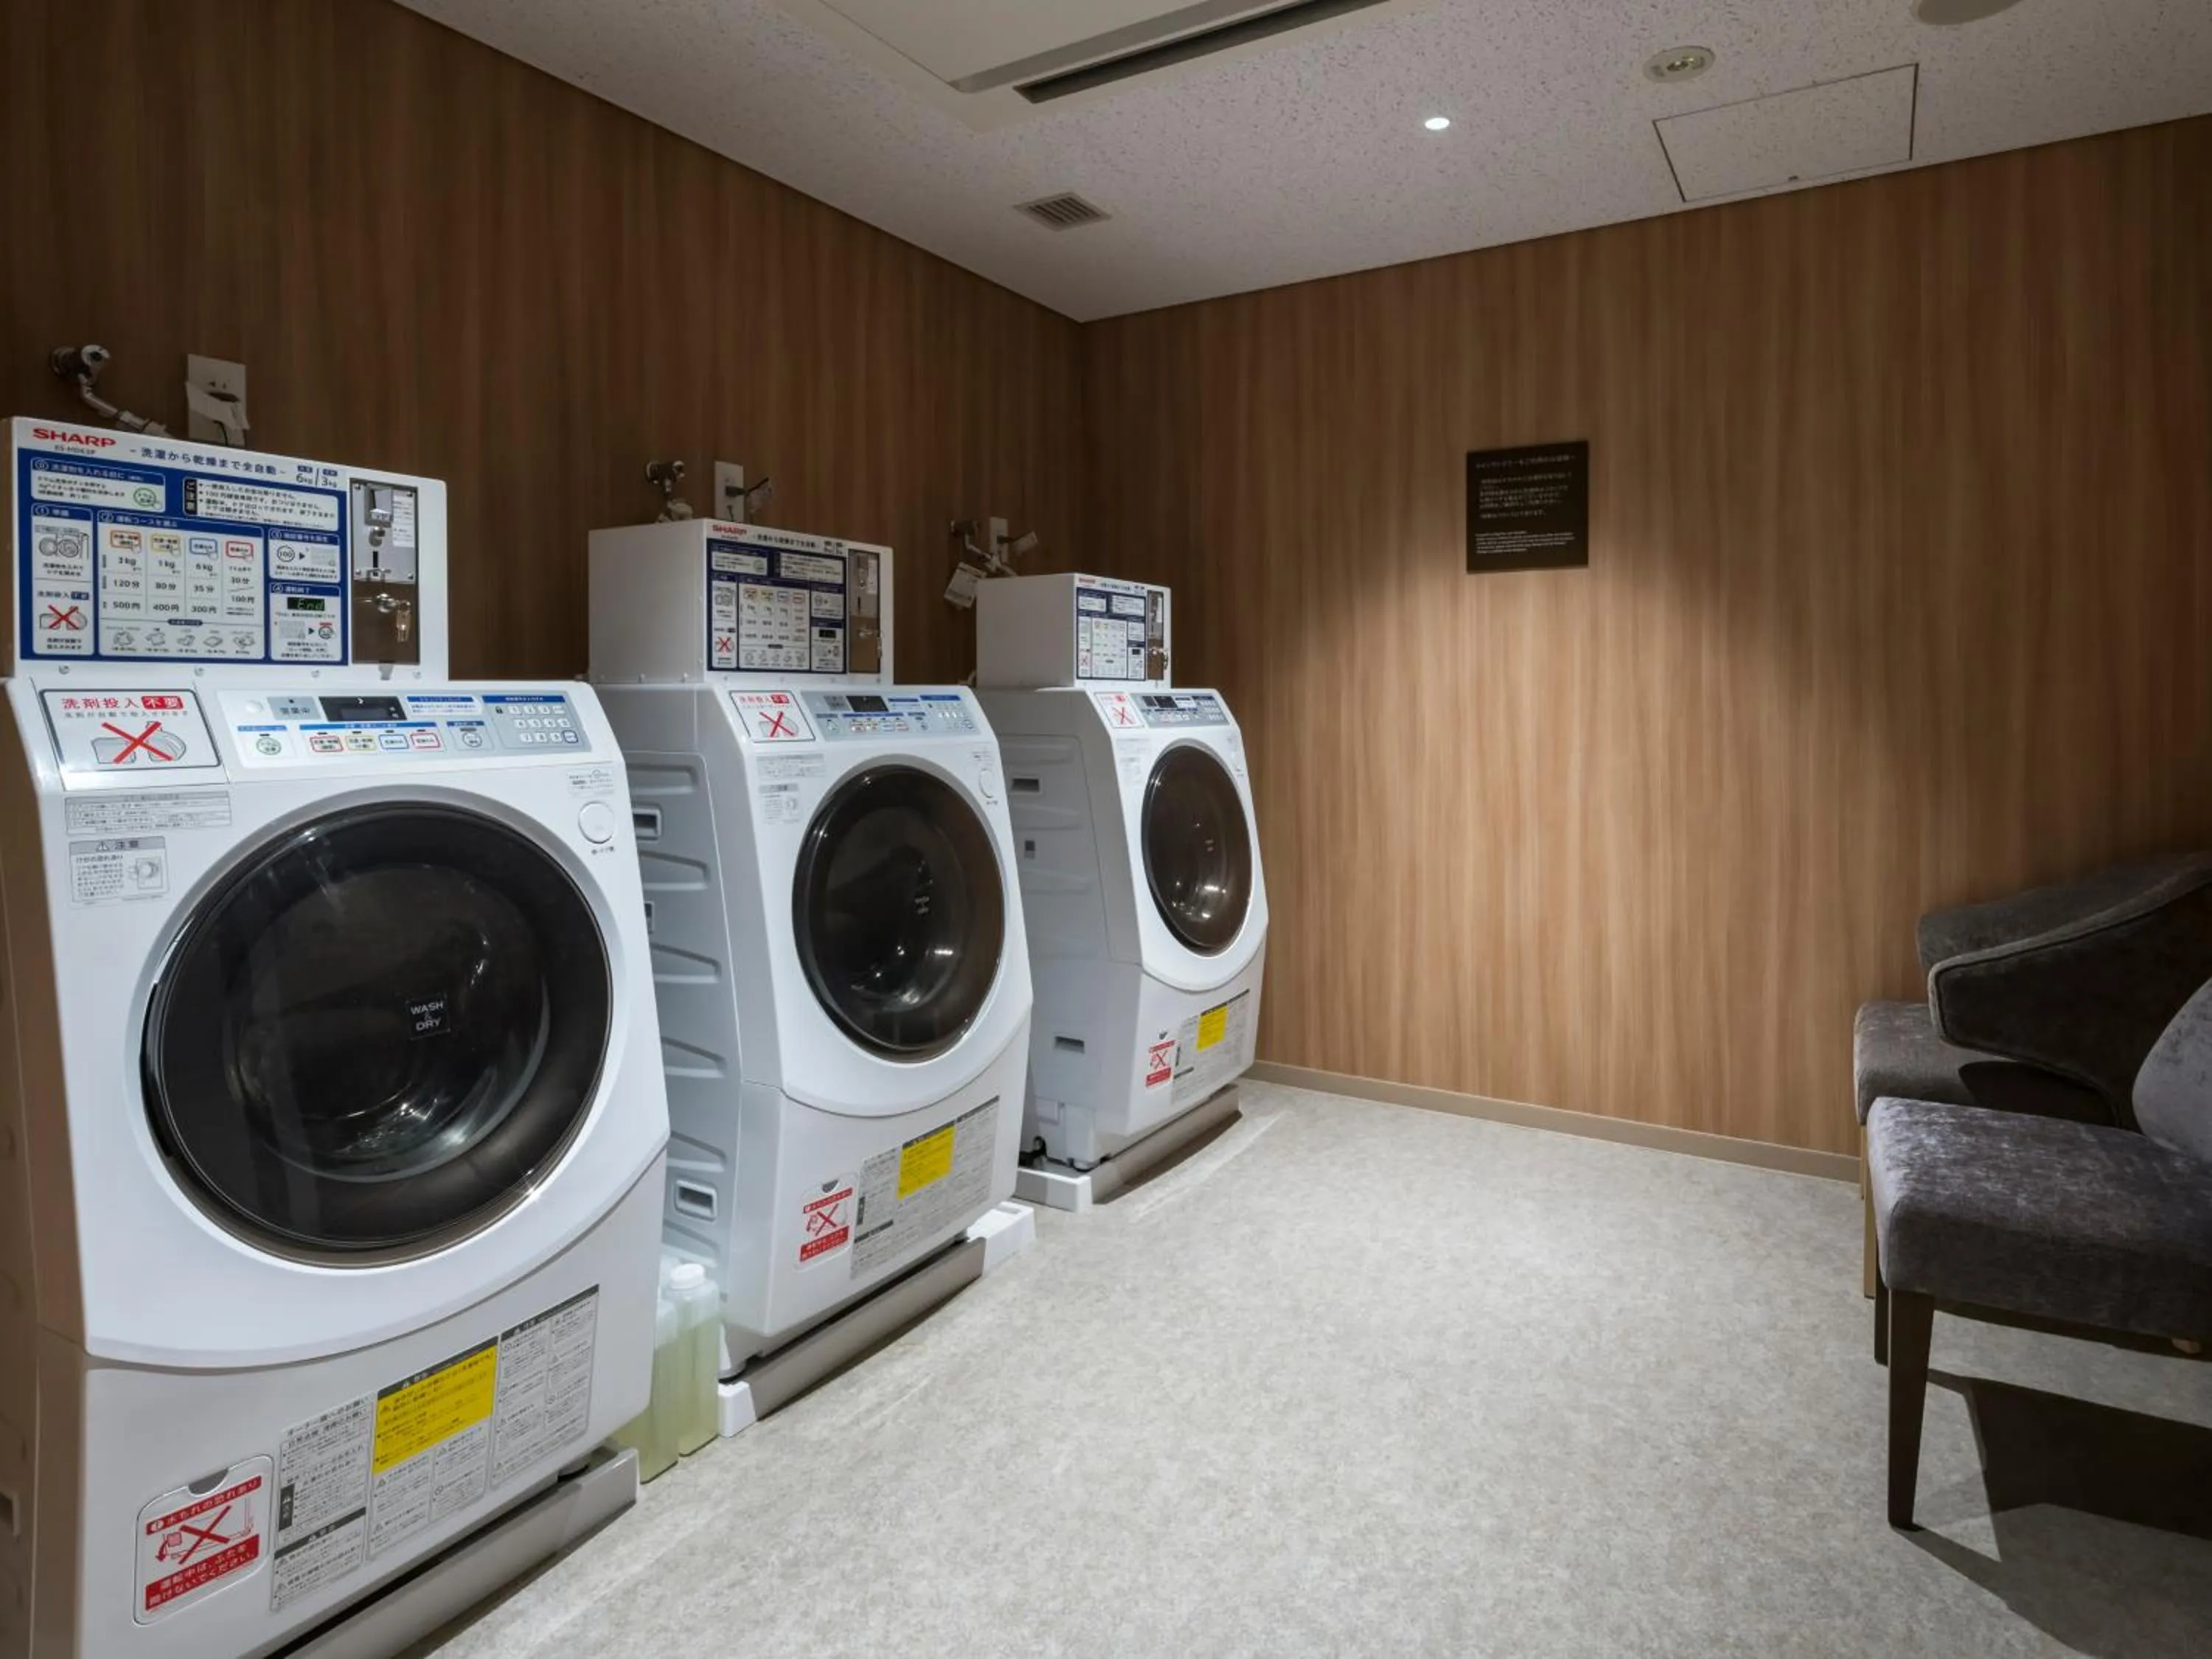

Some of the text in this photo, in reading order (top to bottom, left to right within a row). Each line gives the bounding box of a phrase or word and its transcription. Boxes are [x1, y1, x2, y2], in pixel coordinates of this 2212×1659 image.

[32, 428, 116, 448] SHARP
[141, 447, 277, 475] 洗濯から乾燥まで全自動
[712, 524, 747, 536] SHARP
[114, 579, 140, 589] 120分
[112, 601, 141, 611] 500円
[153, 604, 180, 613] 400円
[231, 594, 255, 605] 100円
[297, 598, 324, 611] End
[62, 697, 183, 709] 洗剤投入 不要
[410, 1001, 444, 1015] WASH
[415, 1017, 442, 1032] DRY
[166, 1479, 258, 1525] 水もれの恐れあり
